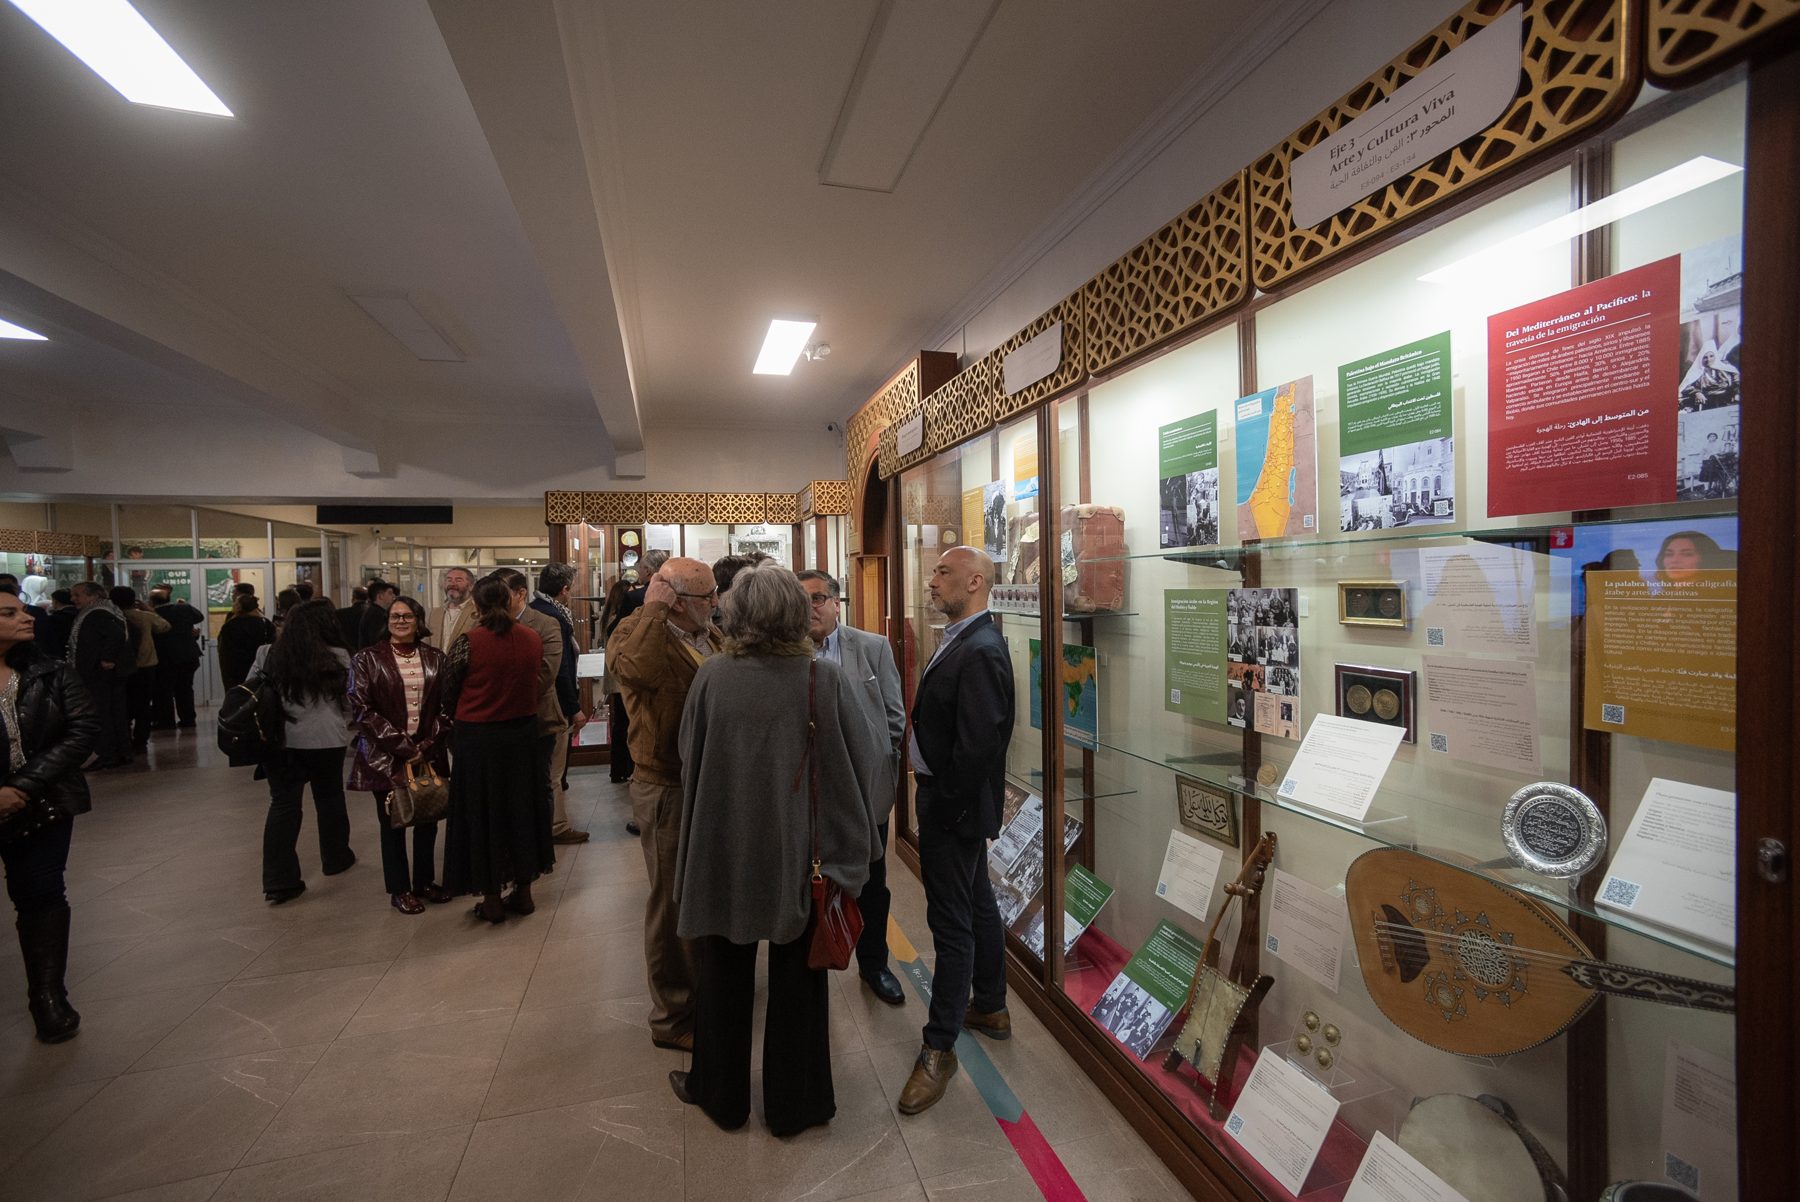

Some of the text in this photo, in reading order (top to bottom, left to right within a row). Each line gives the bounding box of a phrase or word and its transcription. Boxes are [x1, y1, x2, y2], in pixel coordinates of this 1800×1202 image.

[1329, 88, 1456, 176] Arte y Cultura Viva
[1330, 138, 1355, 160] Eje 3
[1506, 289, 1650, 338] Del Mediterráneo al Pacífico: la
[1506, 315, 1605, 347] travesía de la emigración
[1615, 581, 1645, 589] palabra
[1695, 580, 1737, 589] caligrafía
